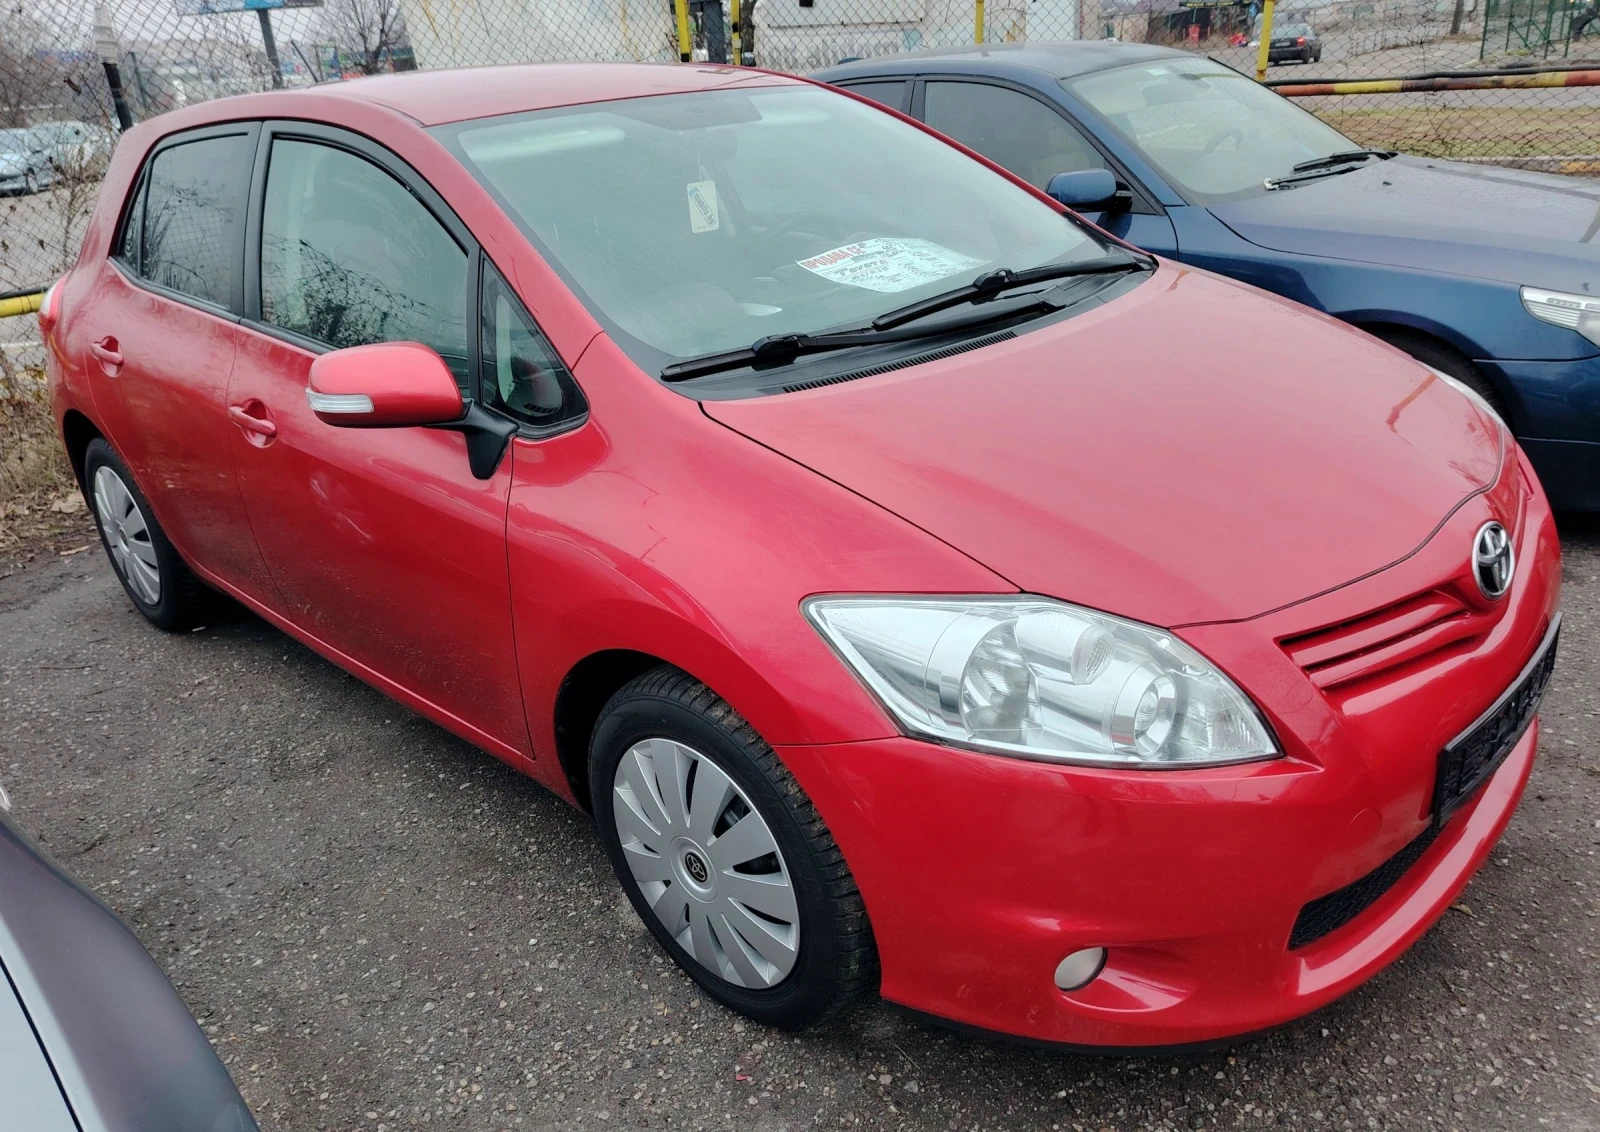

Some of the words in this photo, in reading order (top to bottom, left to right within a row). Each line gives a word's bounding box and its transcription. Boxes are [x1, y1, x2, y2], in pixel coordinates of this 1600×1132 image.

[693, 193, 715, 225] mobile.bg
[800, 250, 853, 269] ПРОДАВА
[847, 245, 866, 255] СЕ
